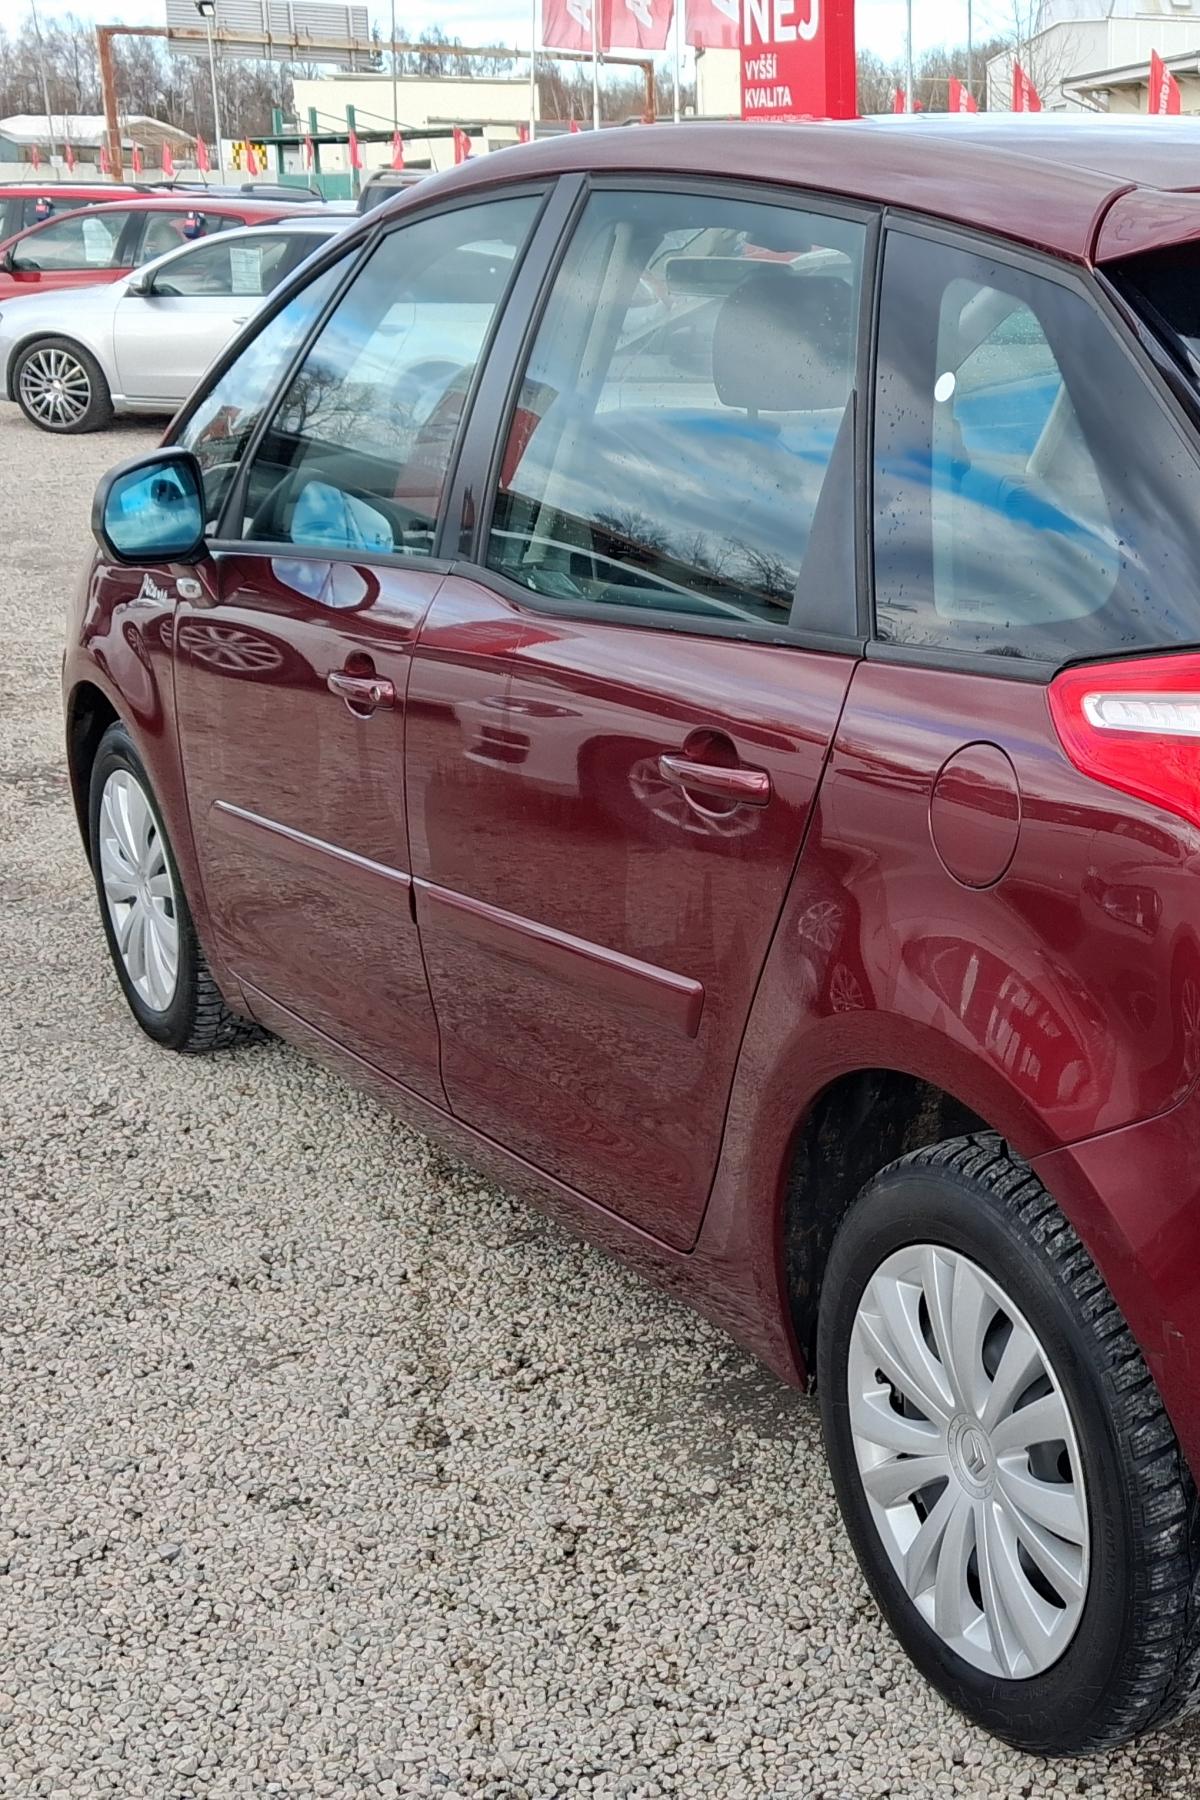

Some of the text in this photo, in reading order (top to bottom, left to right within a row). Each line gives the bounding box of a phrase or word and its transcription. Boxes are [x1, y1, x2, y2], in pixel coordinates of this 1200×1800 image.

[743, 0, 820, 45] NEJ
[745, 53, 777, 80] VYŠŠÍ
[745, 86, 793, 109] KVALITA
